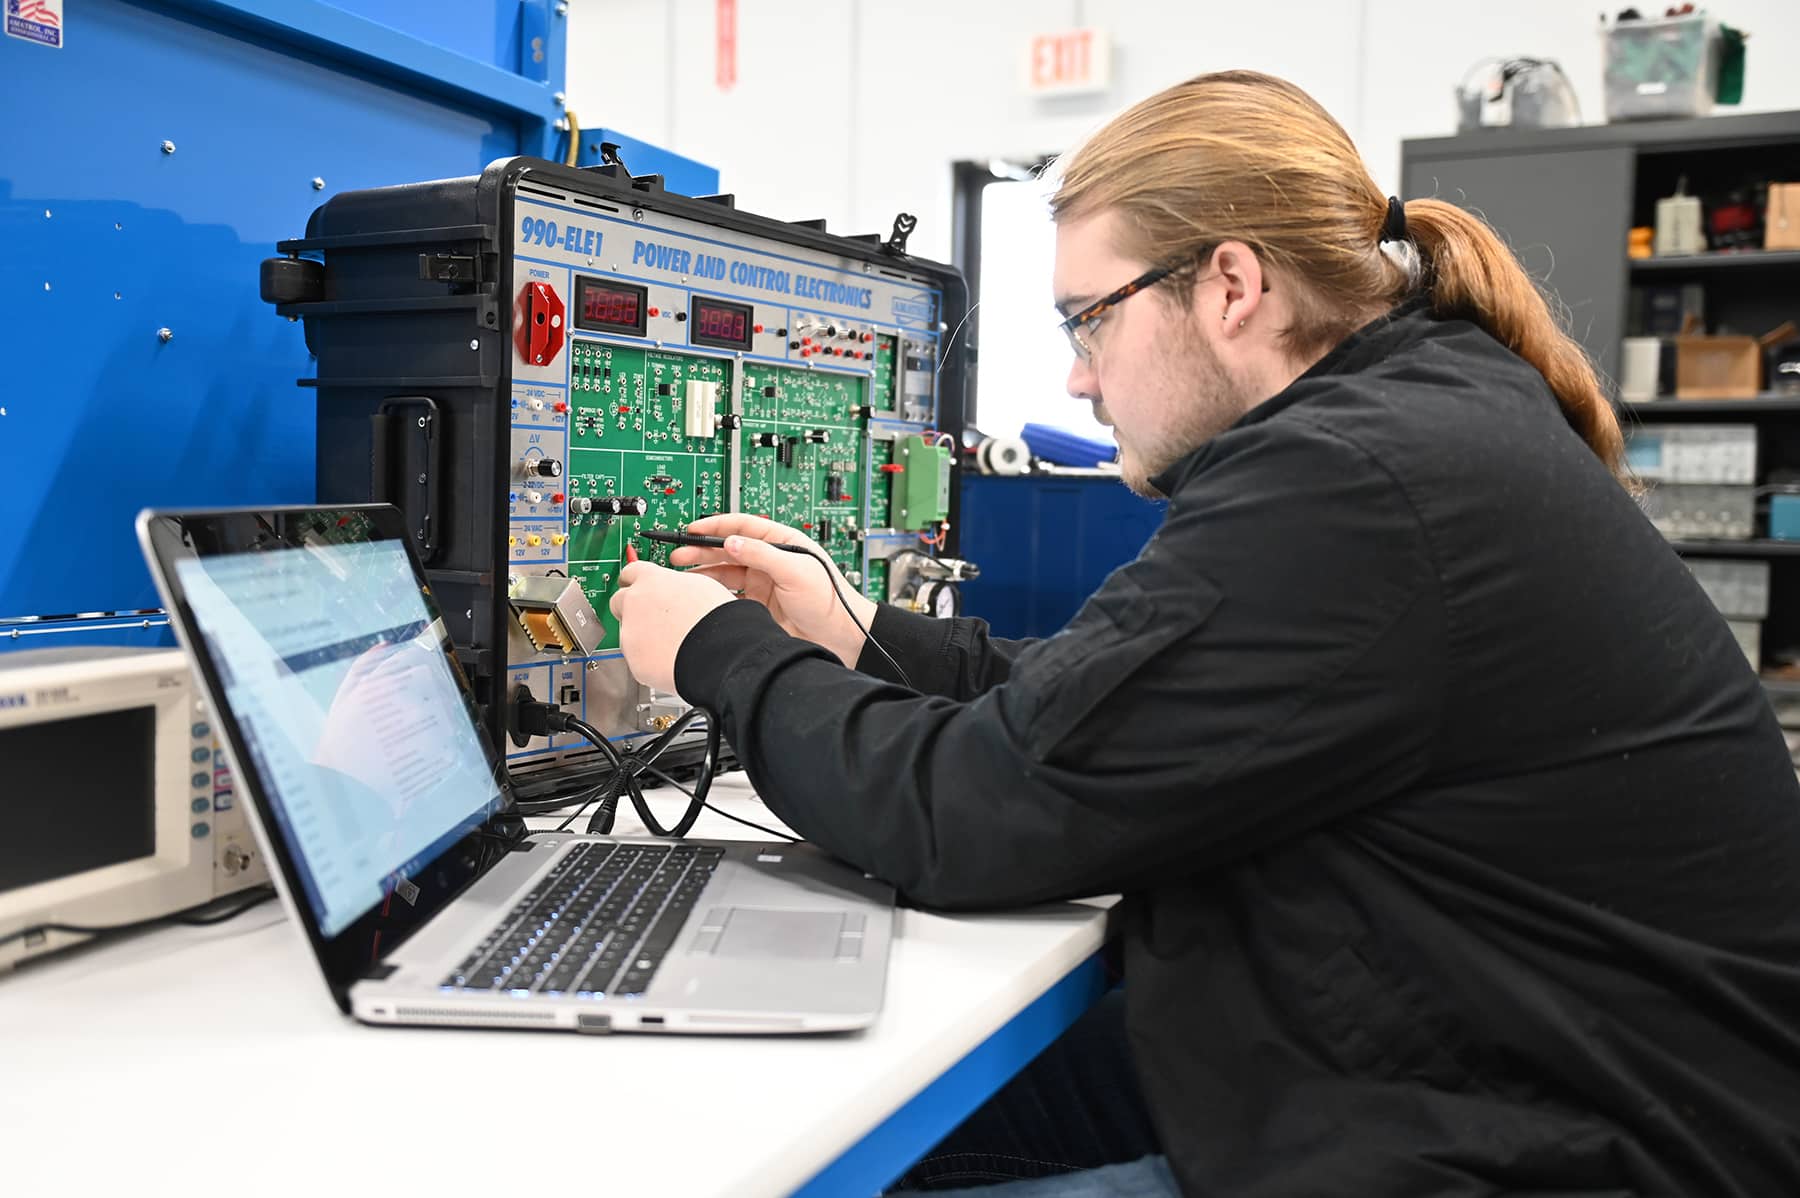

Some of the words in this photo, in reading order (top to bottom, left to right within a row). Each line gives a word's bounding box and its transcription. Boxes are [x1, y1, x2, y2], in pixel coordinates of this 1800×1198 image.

[1030, 31, 1093, 88] EXIT
[521, 216, 603, 257] 990-ELE1
[529, 269, 550, 279] POWER
[633, 240, 691, 274] POWER
[693, 254, 726, 280] AND
[730, 261, 790, 295] CONTROL
[794, 275, 872, 310] ELECTRONICS
[562, 672, 573, 680] USB
